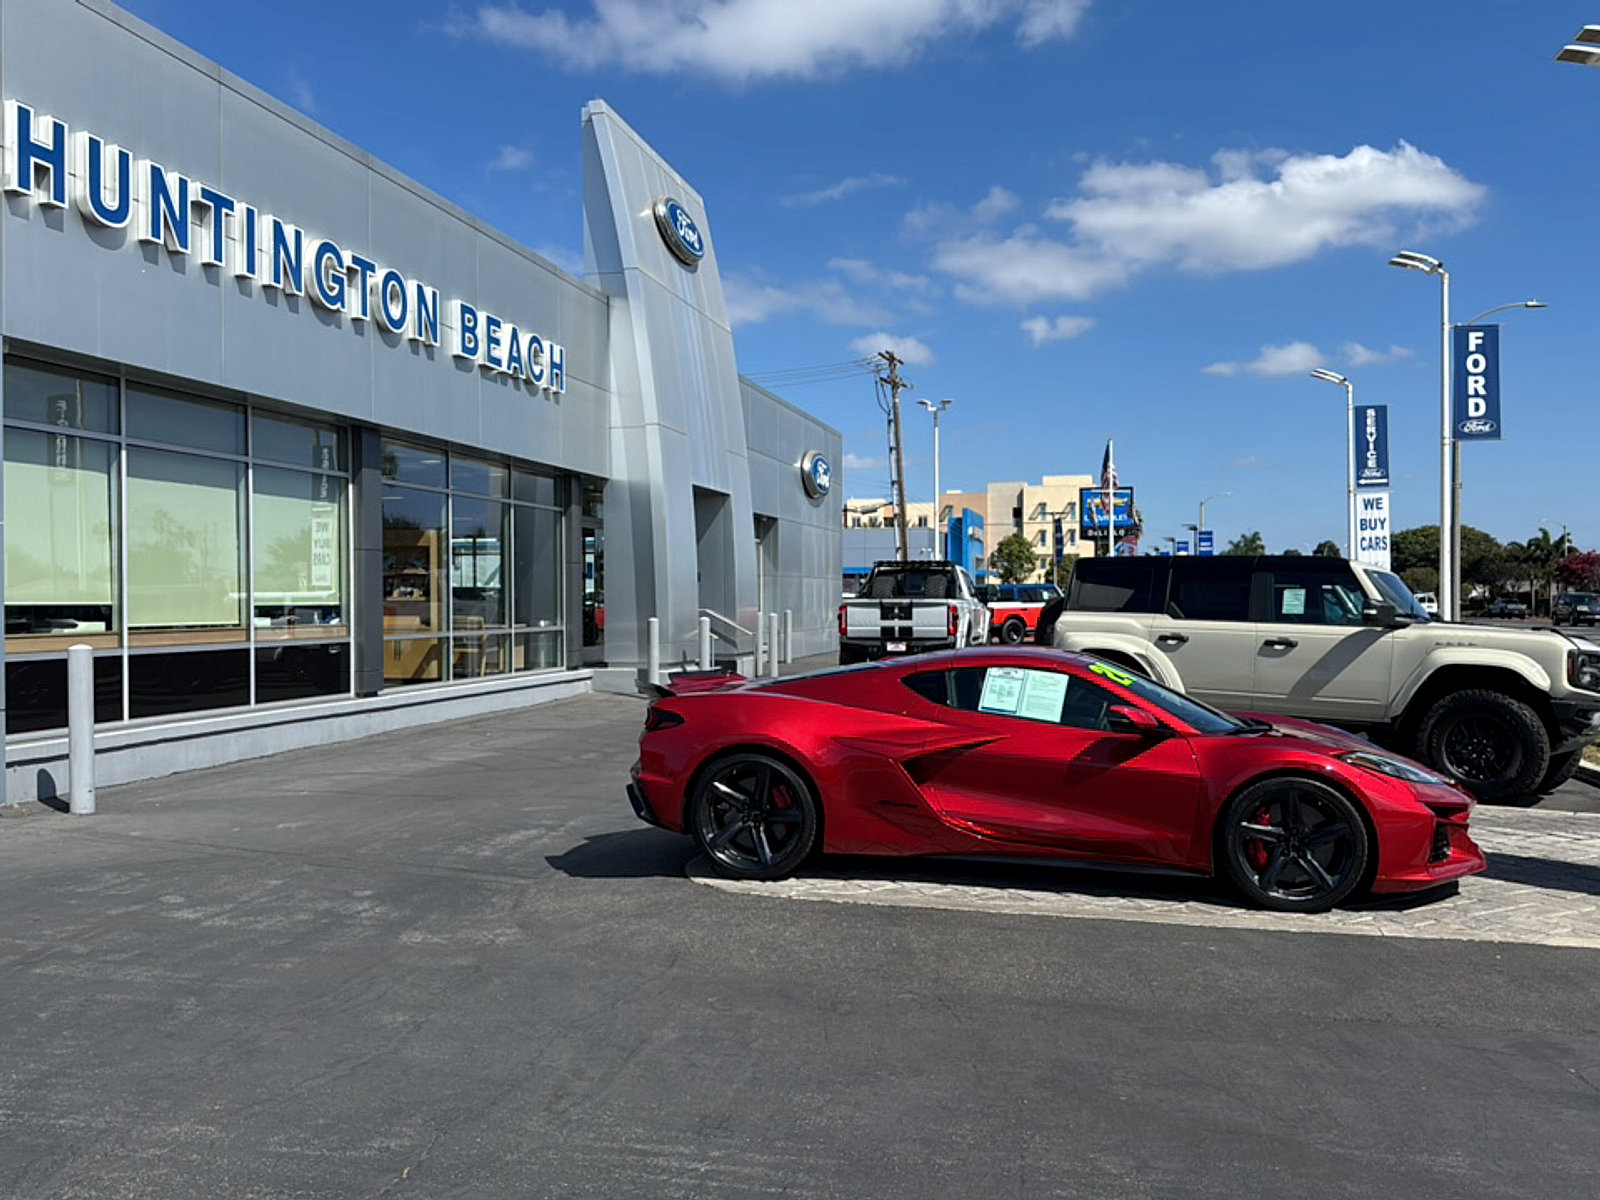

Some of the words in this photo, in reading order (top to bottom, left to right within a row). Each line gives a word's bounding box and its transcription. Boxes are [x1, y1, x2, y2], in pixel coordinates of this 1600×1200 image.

[3, 99, 439, 347] HUNTINGTON
[451, 299, 566, 393] BEACH
[1466, 331, 1487, 418] FORD
[1462, 420, 1493, 433] Ford
[1366, 408, 1377, 468] SERVICE
[1363, 497, 1383, 511] WE
[1360, 517, 1386, 531] BUY
[1360, 536, 1388, 551] CARS
